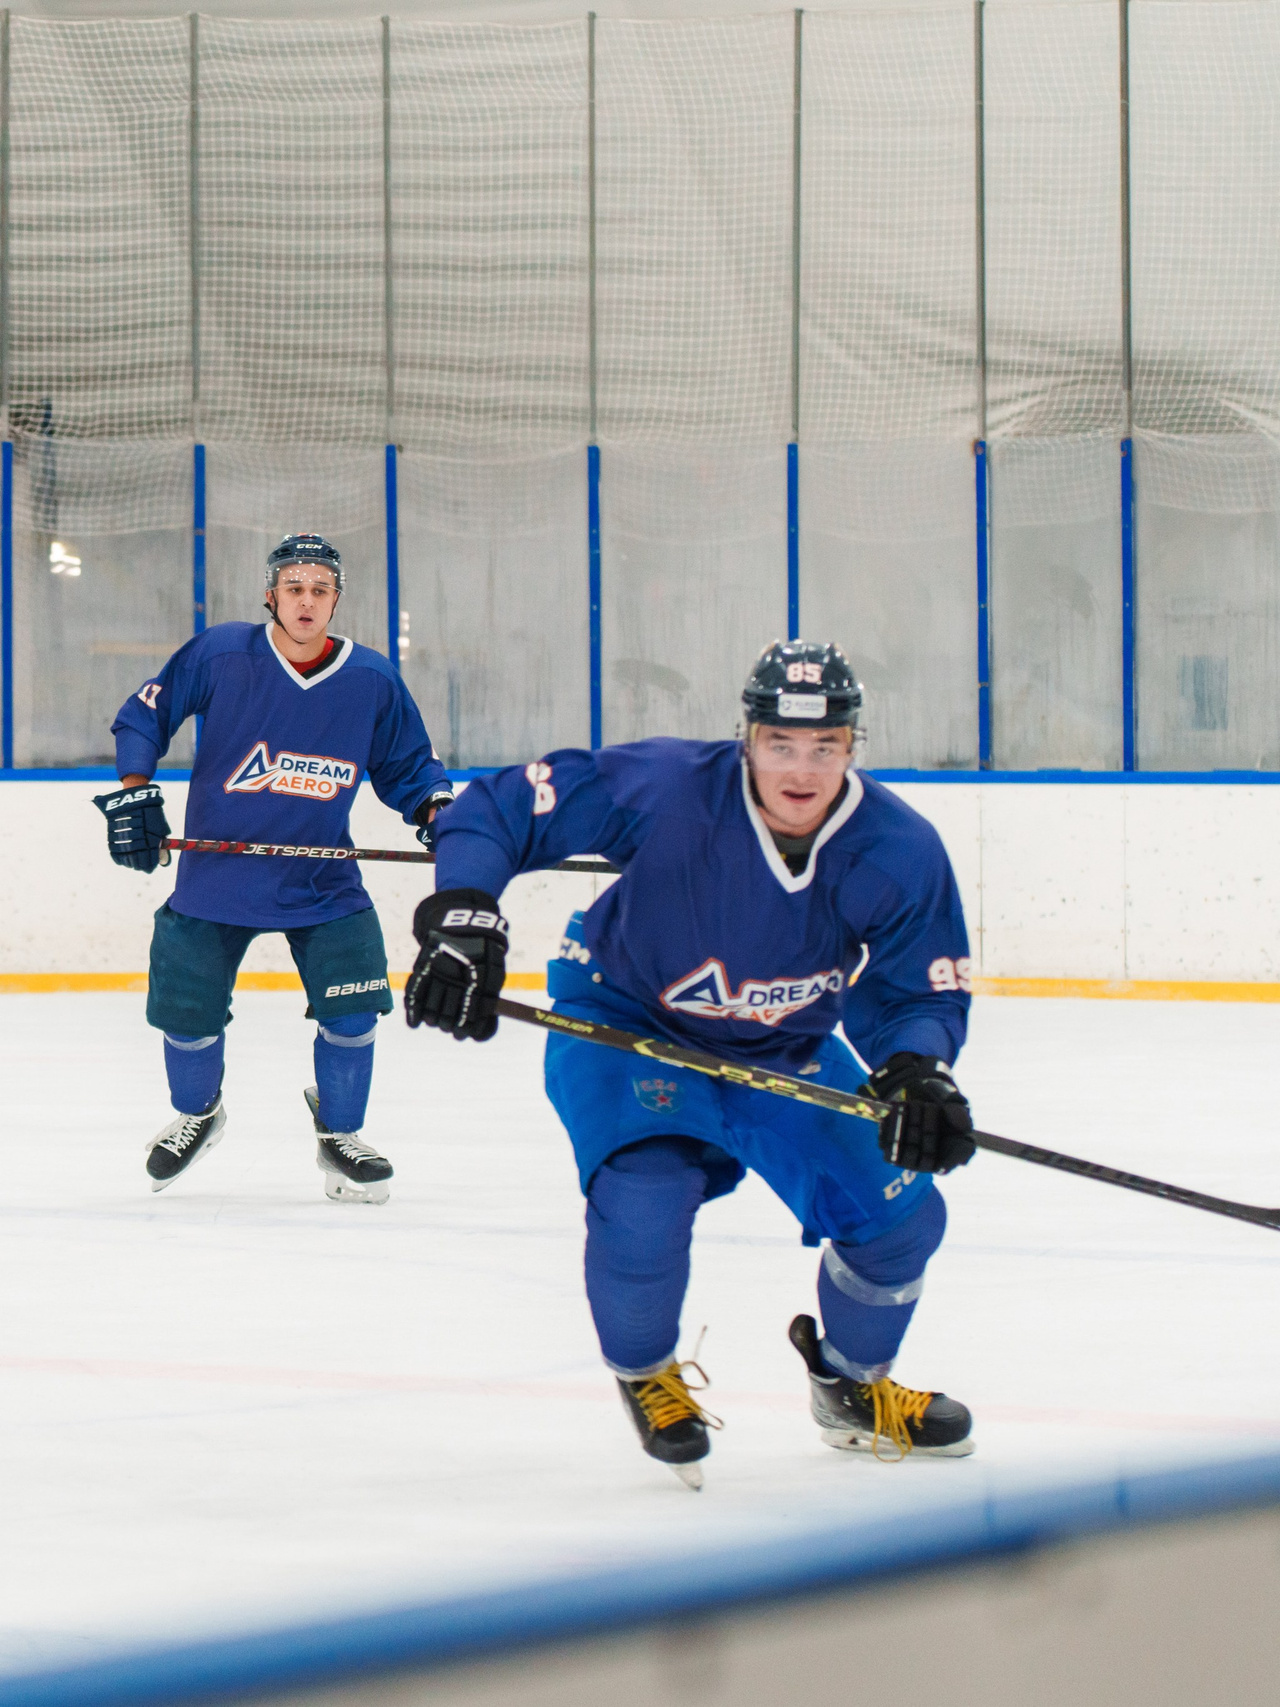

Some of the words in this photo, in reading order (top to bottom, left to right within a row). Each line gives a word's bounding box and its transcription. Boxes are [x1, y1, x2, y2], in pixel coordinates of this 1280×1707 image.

[786, 662, 822, 684] 85
[280, 757, 351, 781] DREAM
[276, 775, 333, 794] AERO
[105, 788, 163, 811] EAST
[242, 843, 348, 860] JETSPEED
[441, 909, 509, 936] BAU
[325, 978, 389, 998] BAUER
[883, 1168, 919, 1201] CC
